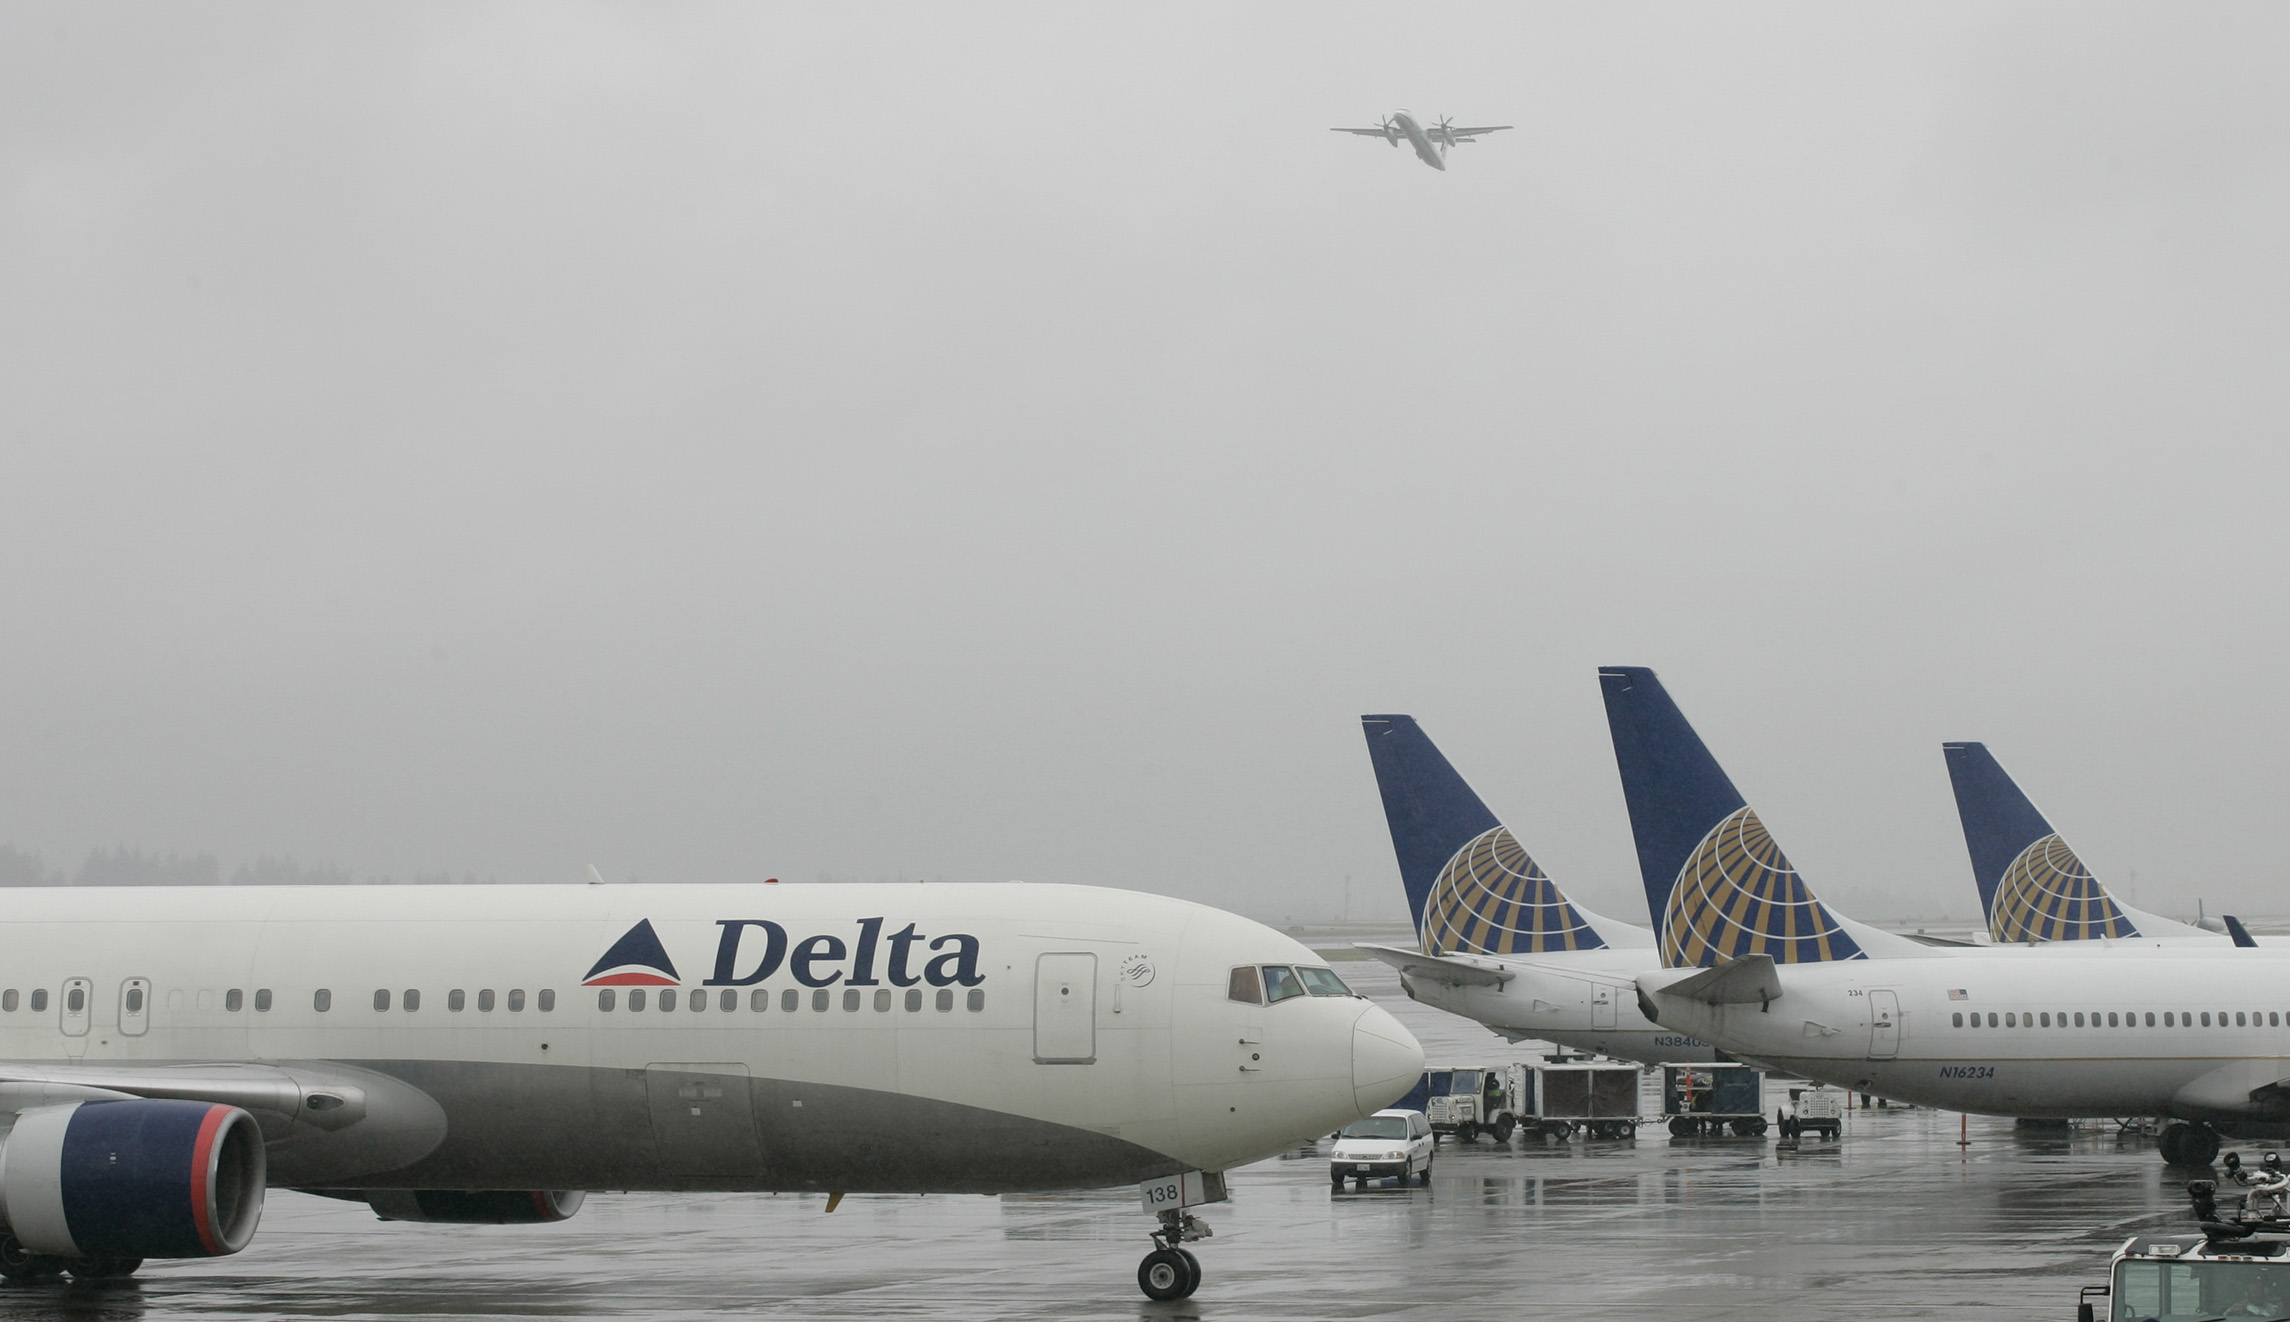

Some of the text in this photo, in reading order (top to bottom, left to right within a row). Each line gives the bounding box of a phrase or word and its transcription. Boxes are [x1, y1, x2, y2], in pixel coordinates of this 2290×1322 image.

[702, 916, 986, 988] Delta
[1847, 989, 1863, 997] 234
[1939, 1066, 1995, 1079] N16234
[1146, 1184, 1178, 1204] 138
